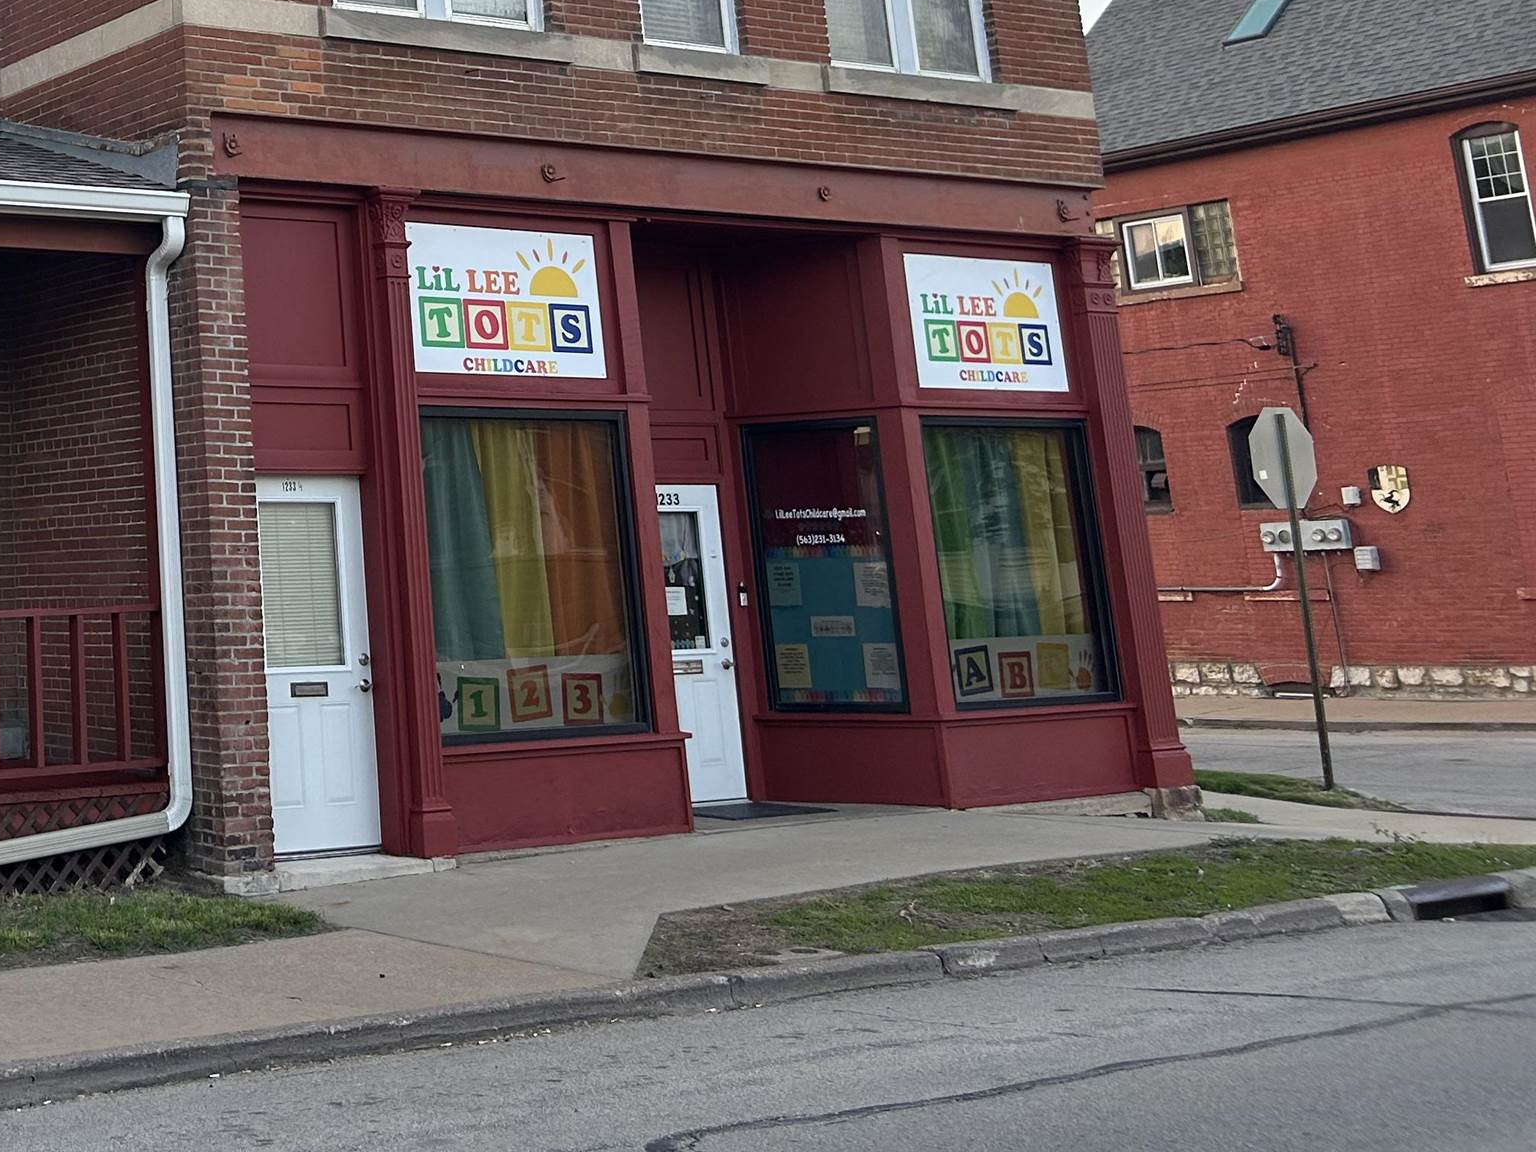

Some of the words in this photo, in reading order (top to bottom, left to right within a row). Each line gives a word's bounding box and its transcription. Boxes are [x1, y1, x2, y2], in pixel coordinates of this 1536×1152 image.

[466, 269, 521, 295] LEE
[957, 296, 997, 317] LEE
[428, 306, 582, 344] TOTS
[931, 327, 1043, 358] TOTS
[463, 357, 559, 374] CHILDCARE
[959, 369, 1029, 384] CHILDCARE
[281, 480, 297, 492] 1233
[965, 656, 986, 687] A
[1007, 661, 1027, 689] B
[469, 690, 488, 718] 1
[519, 680, 540, 708] 2
[573, 684, 593, 714] 3
